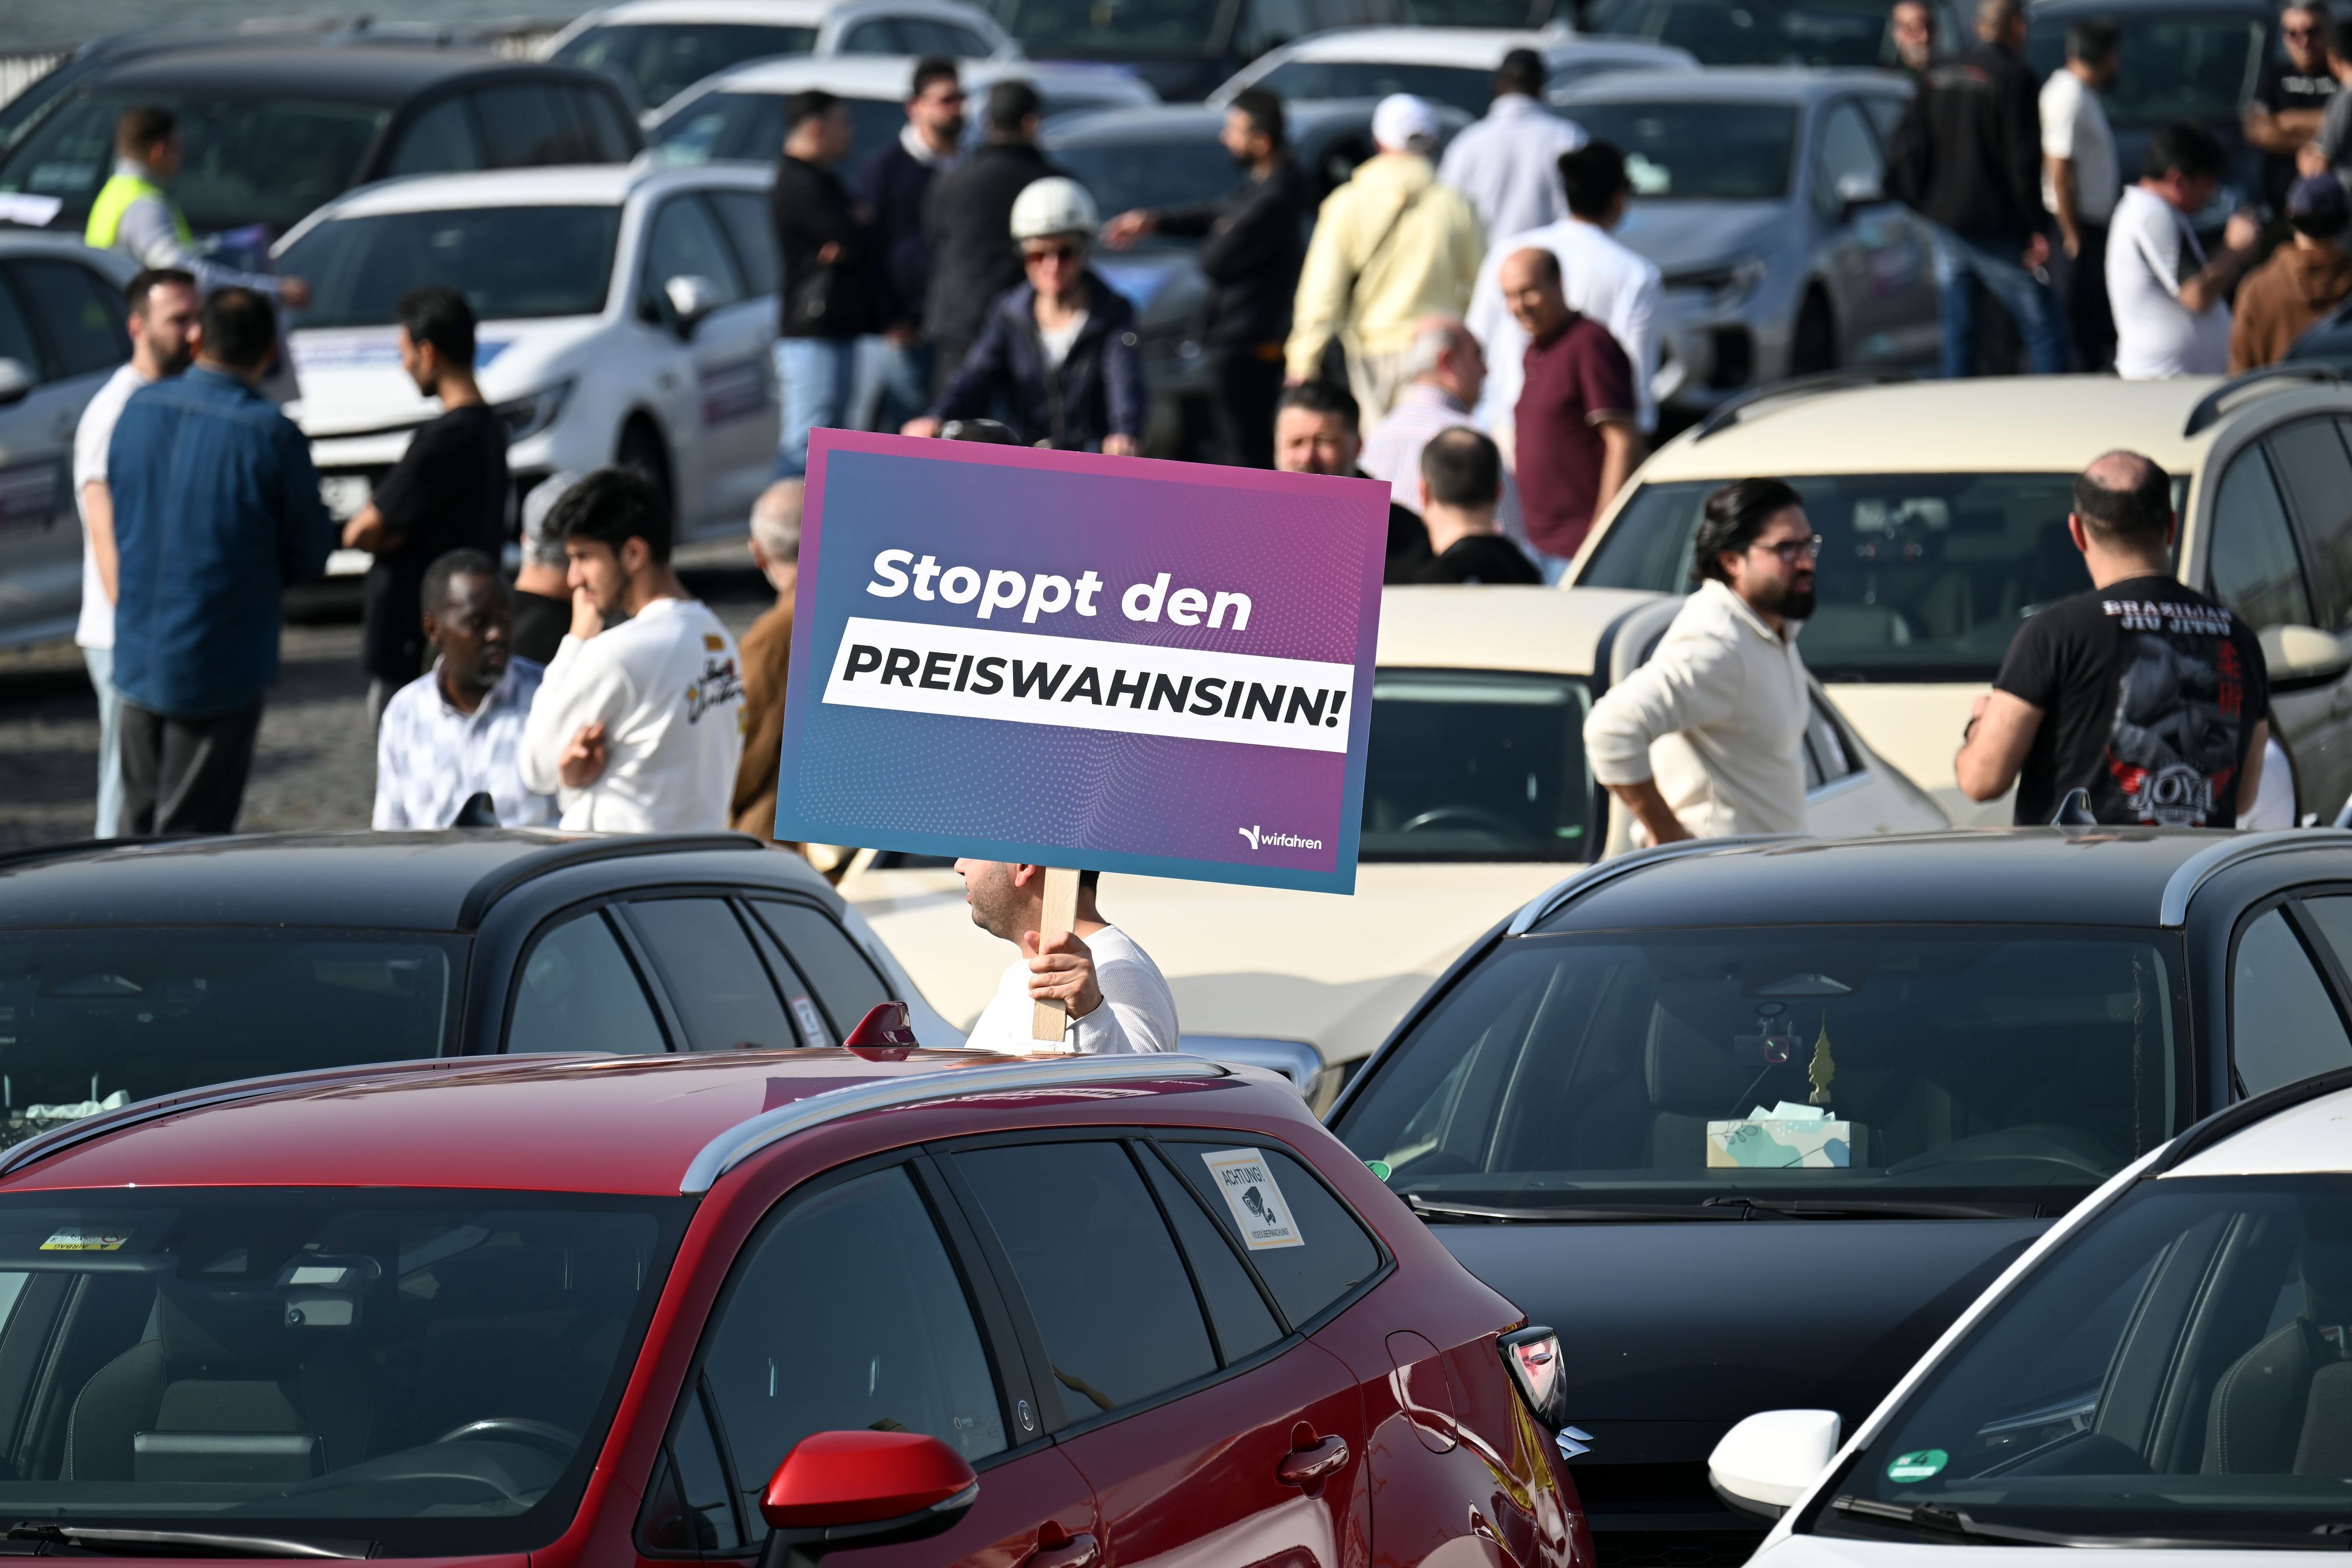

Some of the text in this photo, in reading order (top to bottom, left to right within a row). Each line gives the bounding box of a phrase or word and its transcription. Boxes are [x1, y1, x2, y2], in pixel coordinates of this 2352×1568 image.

[866, 549, 1252, 631] Stoppt den
[2102, 600, 2233, 622] BRAZILIAN
[2120, 616, 2231, 636] JIU JITSU
[843, 644, 1347, 728] PREISWAHNSINN!
[2128, 774, 2219, 815] JOYA
[1261, 833, 1322, 850] wirfahren
[1222, 1166, 1265, 1186] ACHTUNG!
[1251, 1227, 1290, 1239] VIDEOÜBERWACHUNG!
[1912, 1451, 1929, 1466] 4
